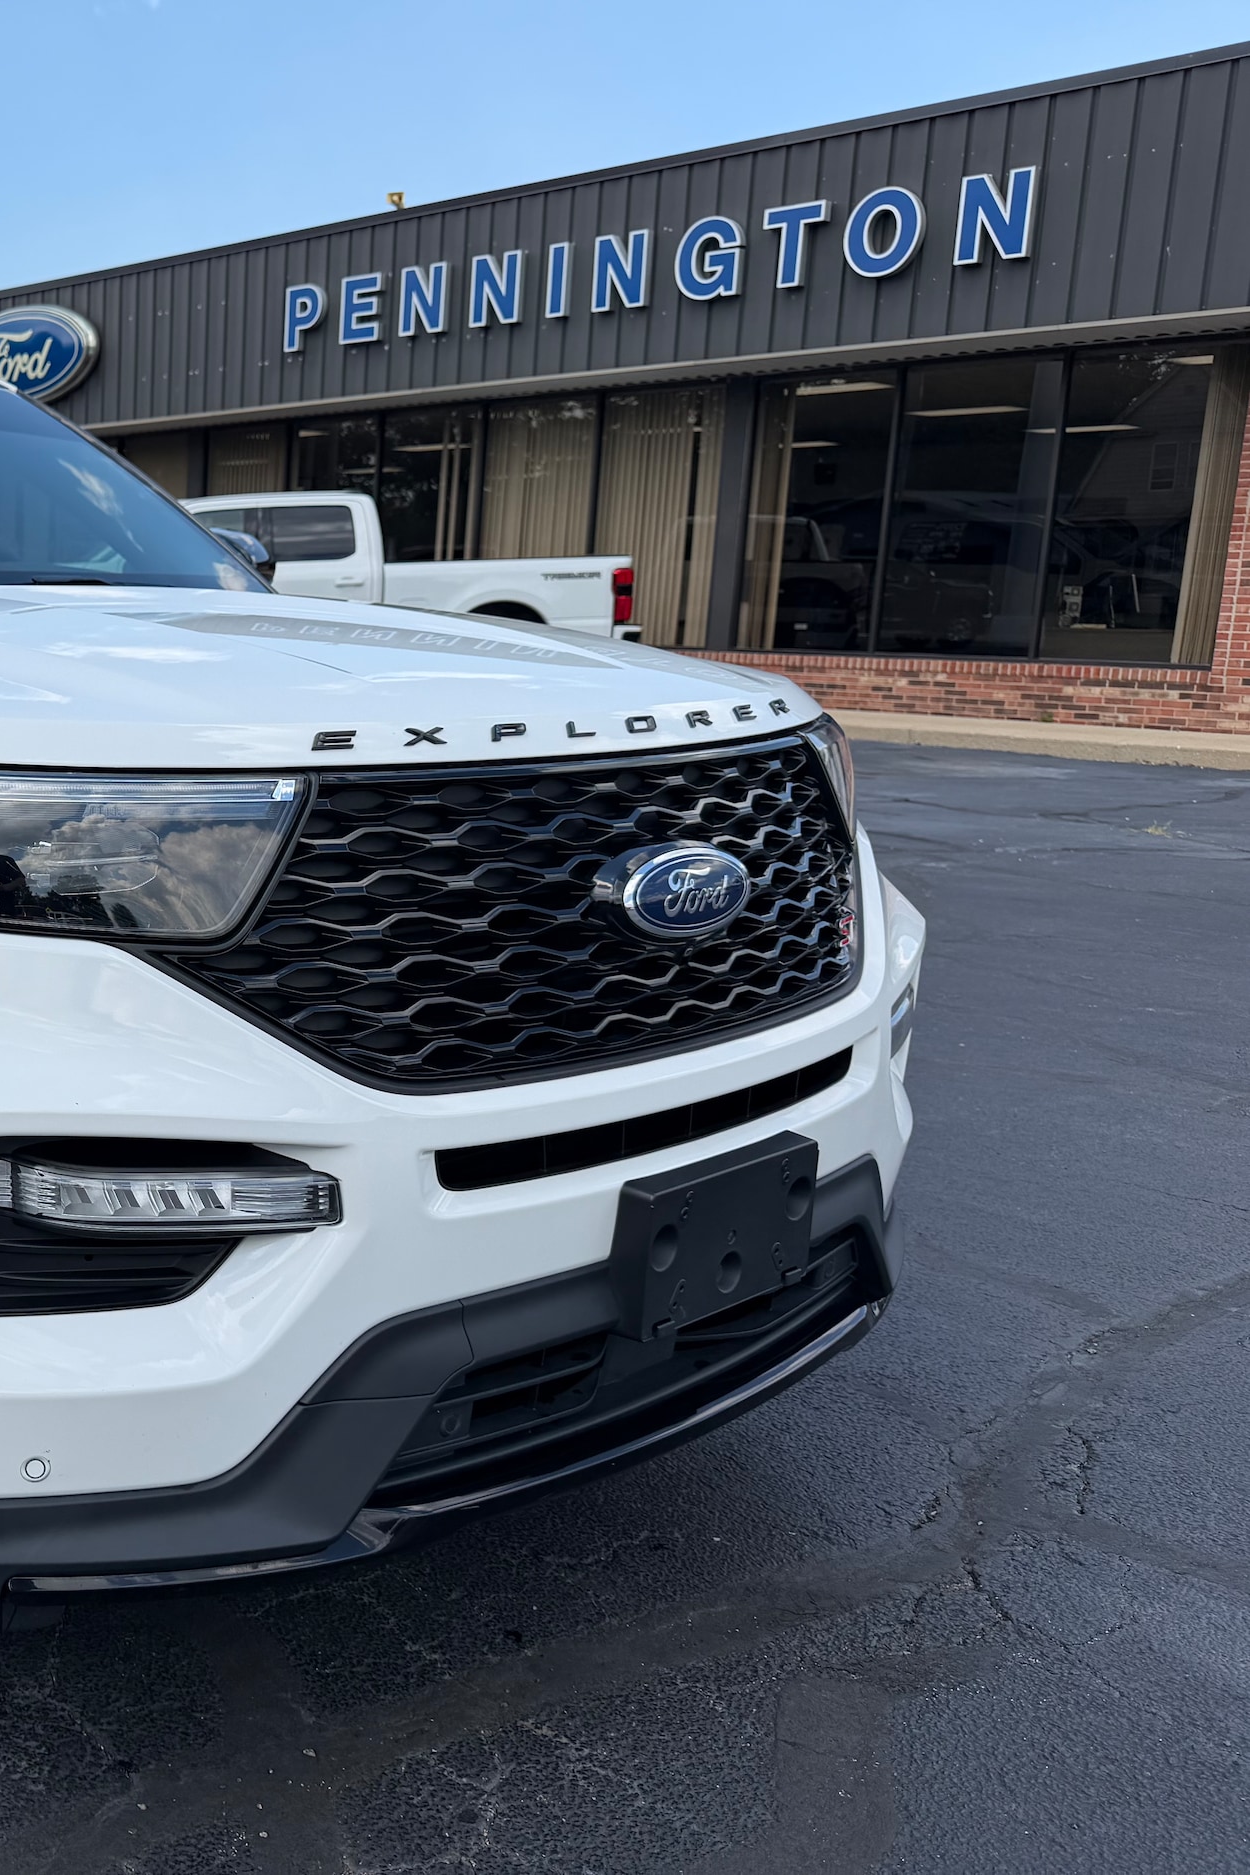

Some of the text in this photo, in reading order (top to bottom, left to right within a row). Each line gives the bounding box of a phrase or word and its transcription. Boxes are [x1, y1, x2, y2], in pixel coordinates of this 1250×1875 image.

[283, 166, 1037, 352] PENNINGTON
[311, 698, 791, 751] EXPLORER
[664, 867, 729, 918] Ford
